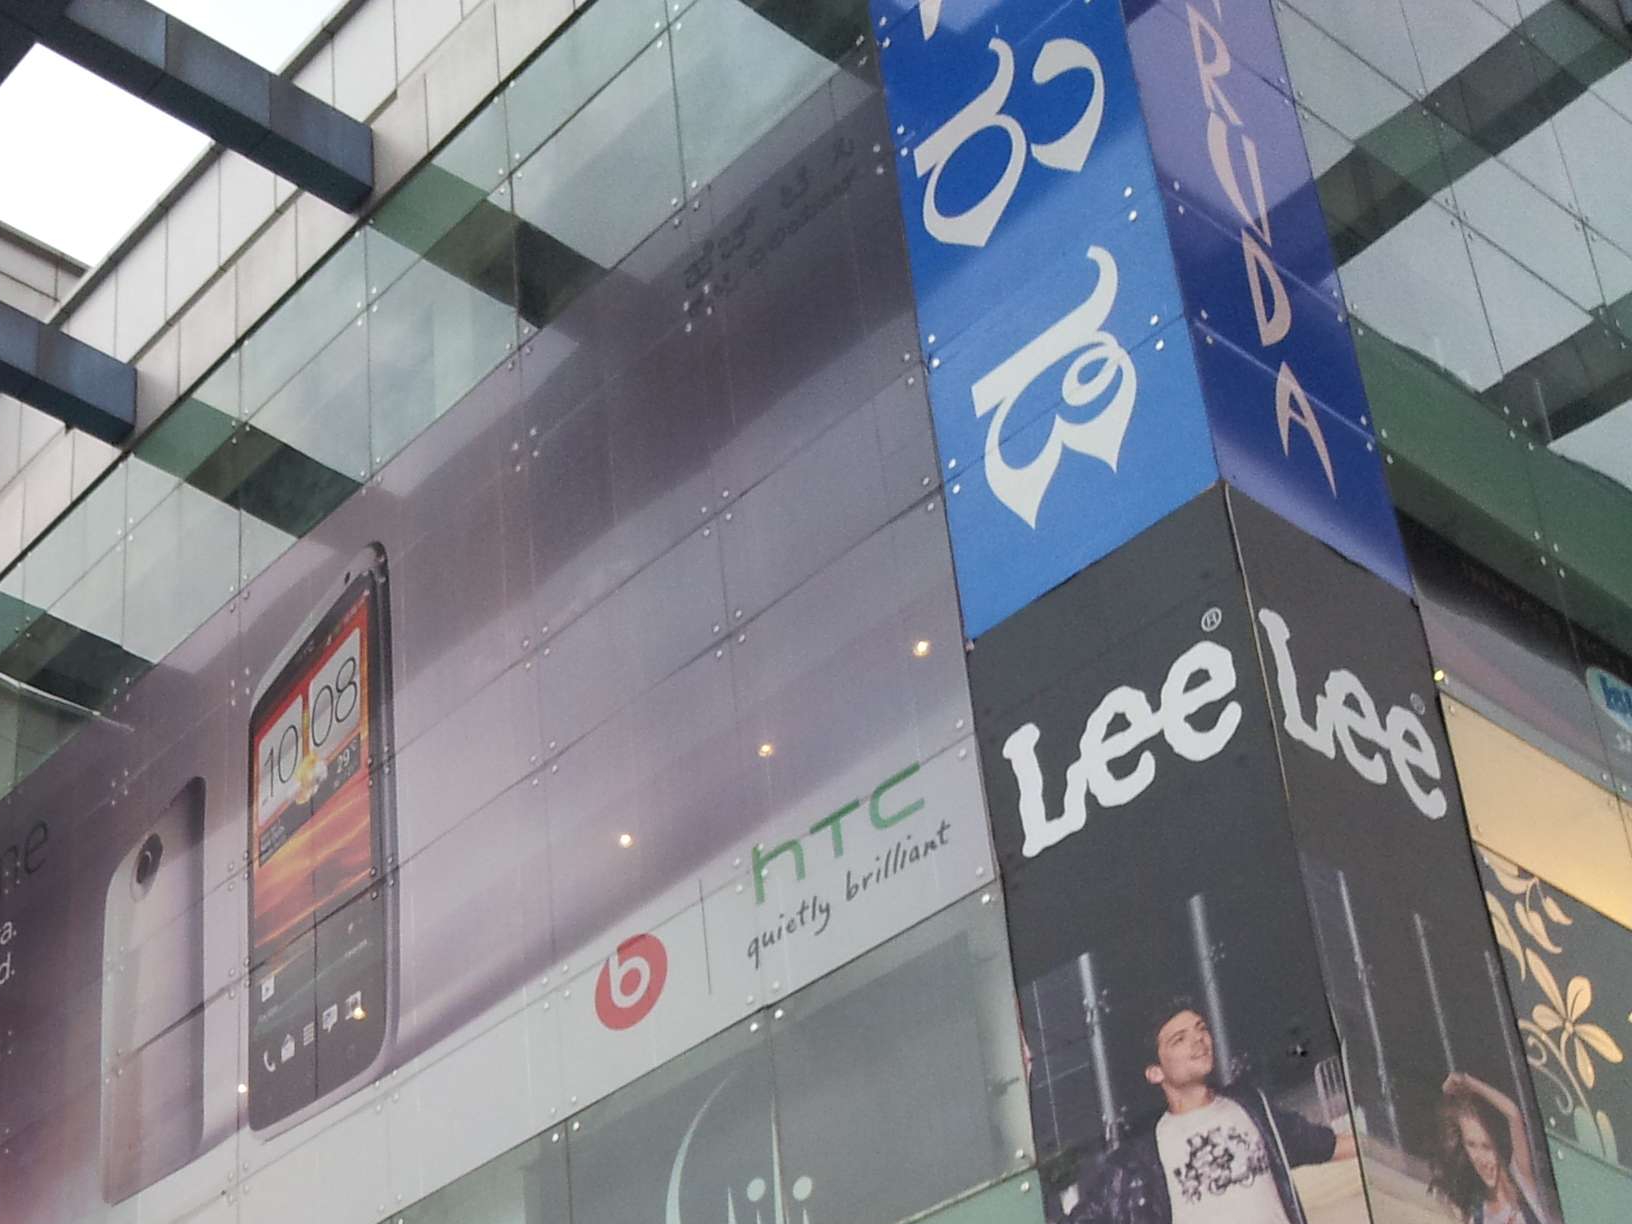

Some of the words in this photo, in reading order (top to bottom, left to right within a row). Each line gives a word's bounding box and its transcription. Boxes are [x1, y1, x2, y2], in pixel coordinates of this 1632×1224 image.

[913, 0, 1137, 530] ರುಡ
[1185, 0, 1338, 499] RUDA
[310, 655, 358, 748] 08
[1002, 641, 1243, 858] Lee
[1258, 607, 1448, 820] Lee
[747, 895, 832, 970] quietly
[845, 819, 953, 902] brilliant
